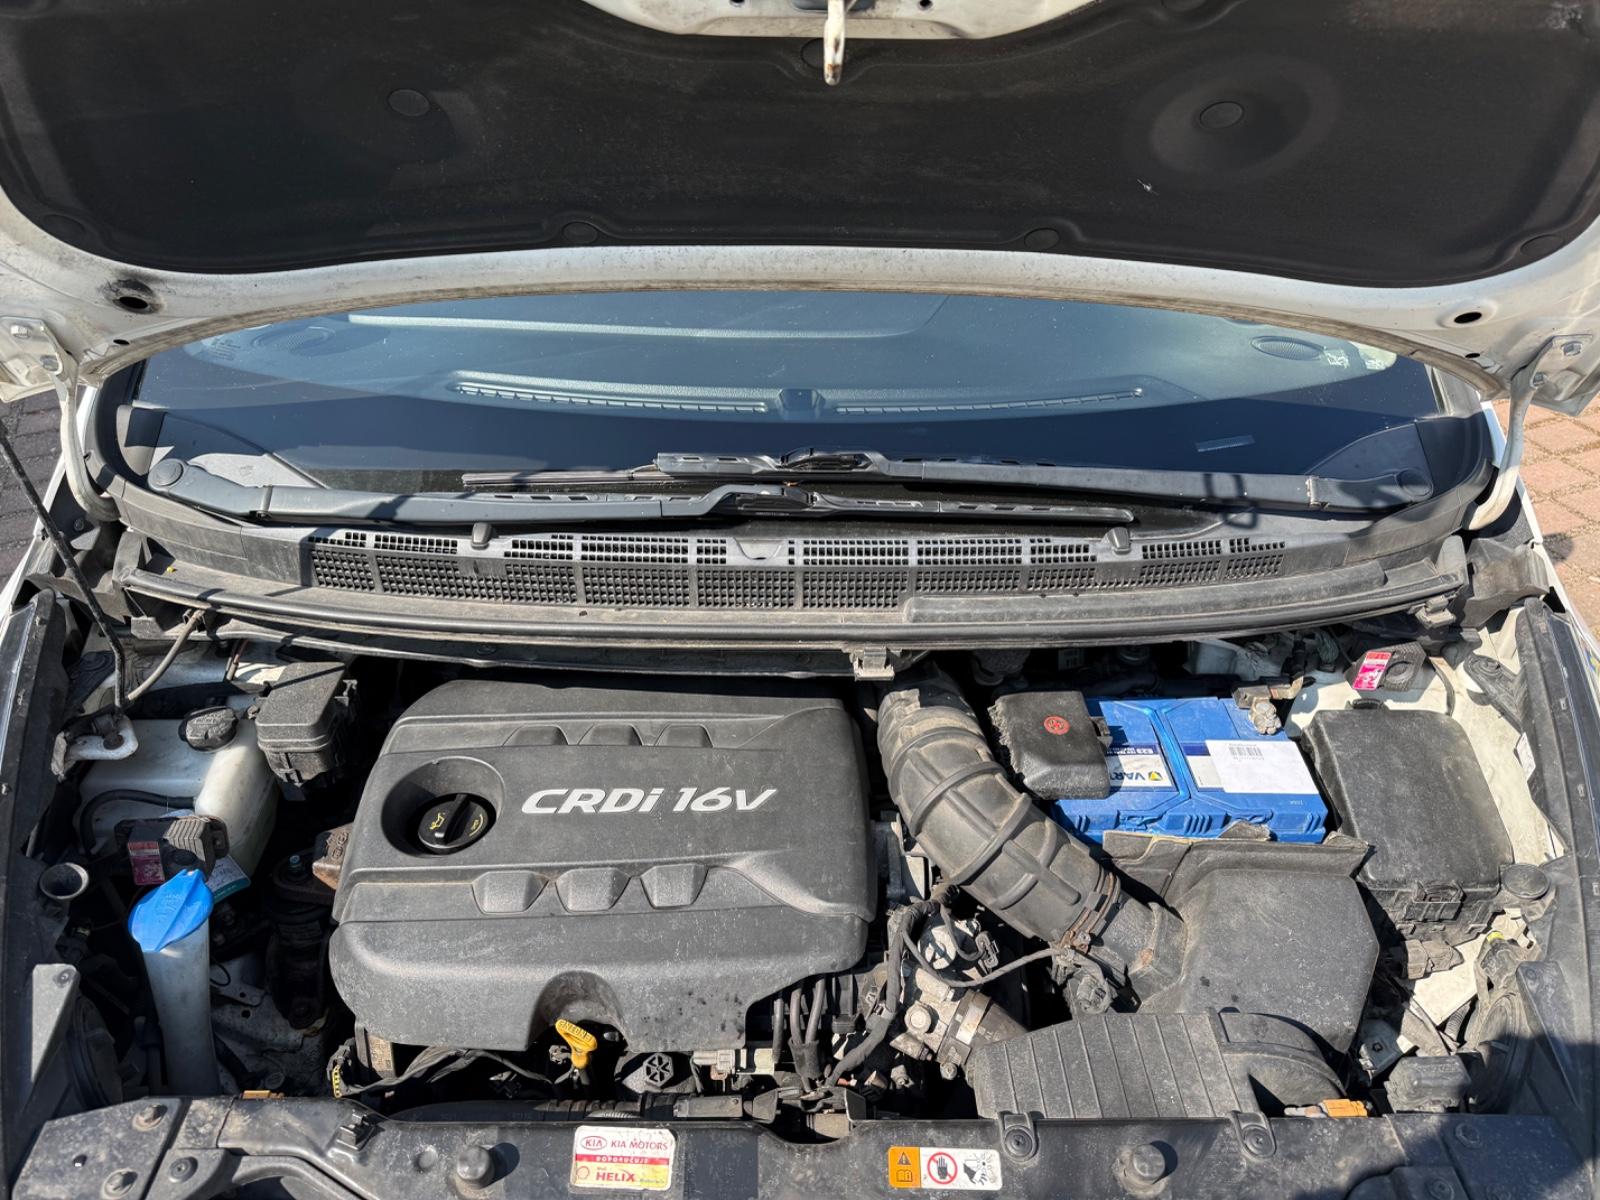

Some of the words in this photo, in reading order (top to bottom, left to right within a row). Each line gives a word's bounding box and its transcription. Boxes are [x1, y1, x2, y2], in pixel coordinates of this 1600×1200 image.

[521, 787, 665, 814] CRDi
[672, 787, 778, 812] 16V
[585, 1139, 603, 1147] KIA
[610, 1140, 627, 1148] KIA
[628, 1141, 668, 1150] MOTORS
[596, 1171, 636, 1182] HELIX
